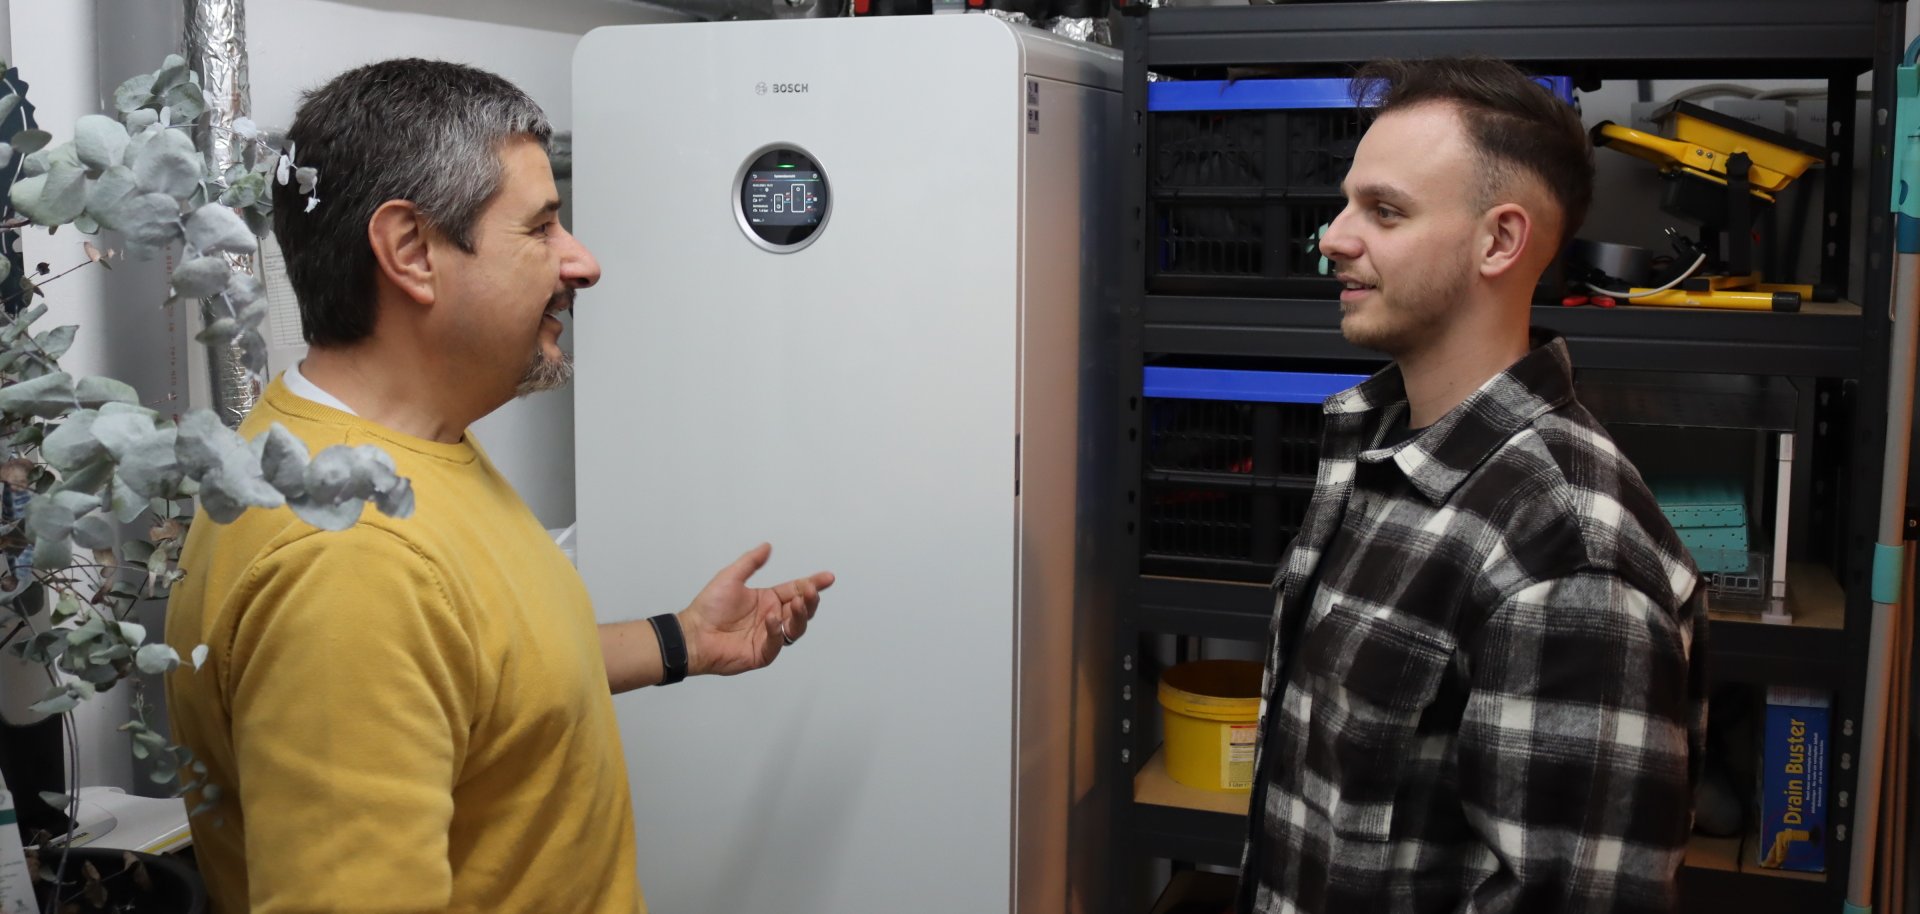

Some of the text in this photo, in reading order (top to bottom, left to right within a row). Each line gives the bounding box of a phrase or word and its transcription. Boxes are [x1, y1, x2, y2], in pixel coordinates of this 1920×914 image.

[772, 83, 809, 93] BOSCH
[1783, 718, 1806, 825] Drain Buster
